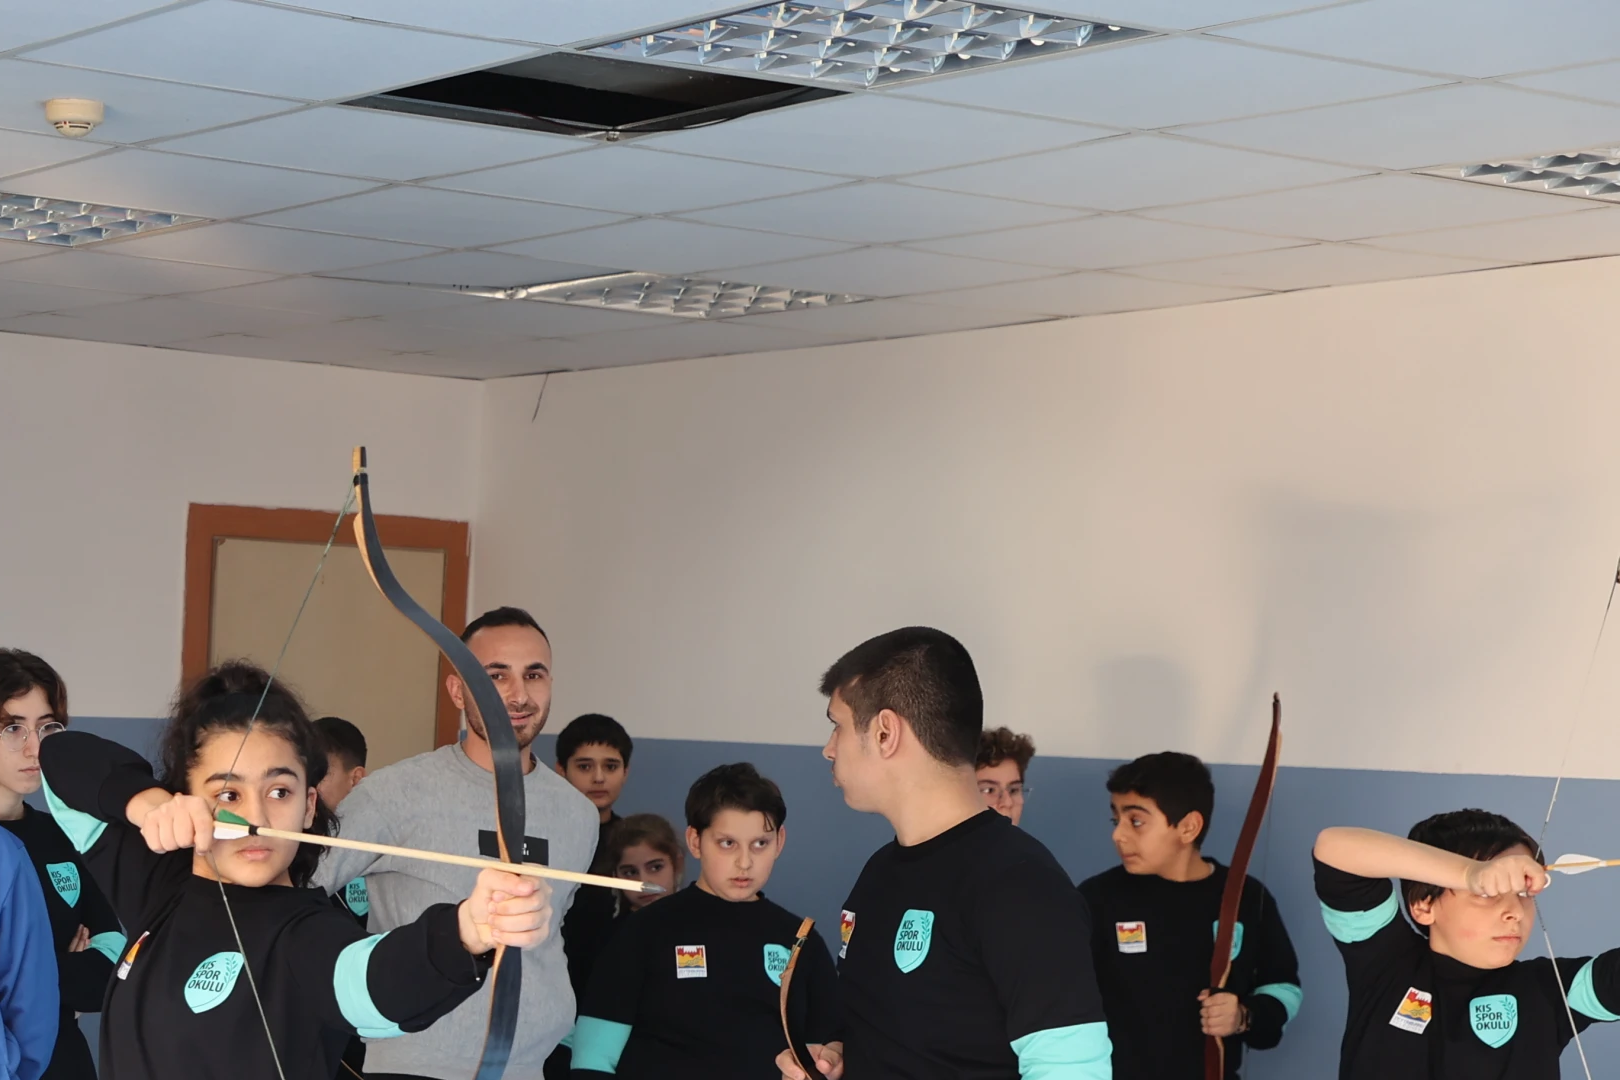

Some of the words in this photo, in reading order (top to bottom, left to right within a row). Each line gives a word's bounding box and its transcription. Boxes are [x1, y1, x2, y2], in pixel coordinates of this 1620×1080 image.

[54, 876, 72, 885] SPOR
[898, 930, 919, 940] SPOR
[896, 941, 924, 952] OKULU
[193, 970, 221, 980] SPOR
[188, 980, 224, 992] OKULU
[1476, 1012, 1502, 1022] SPOR
[1476, 1021, 1510, 1031] OKULU
